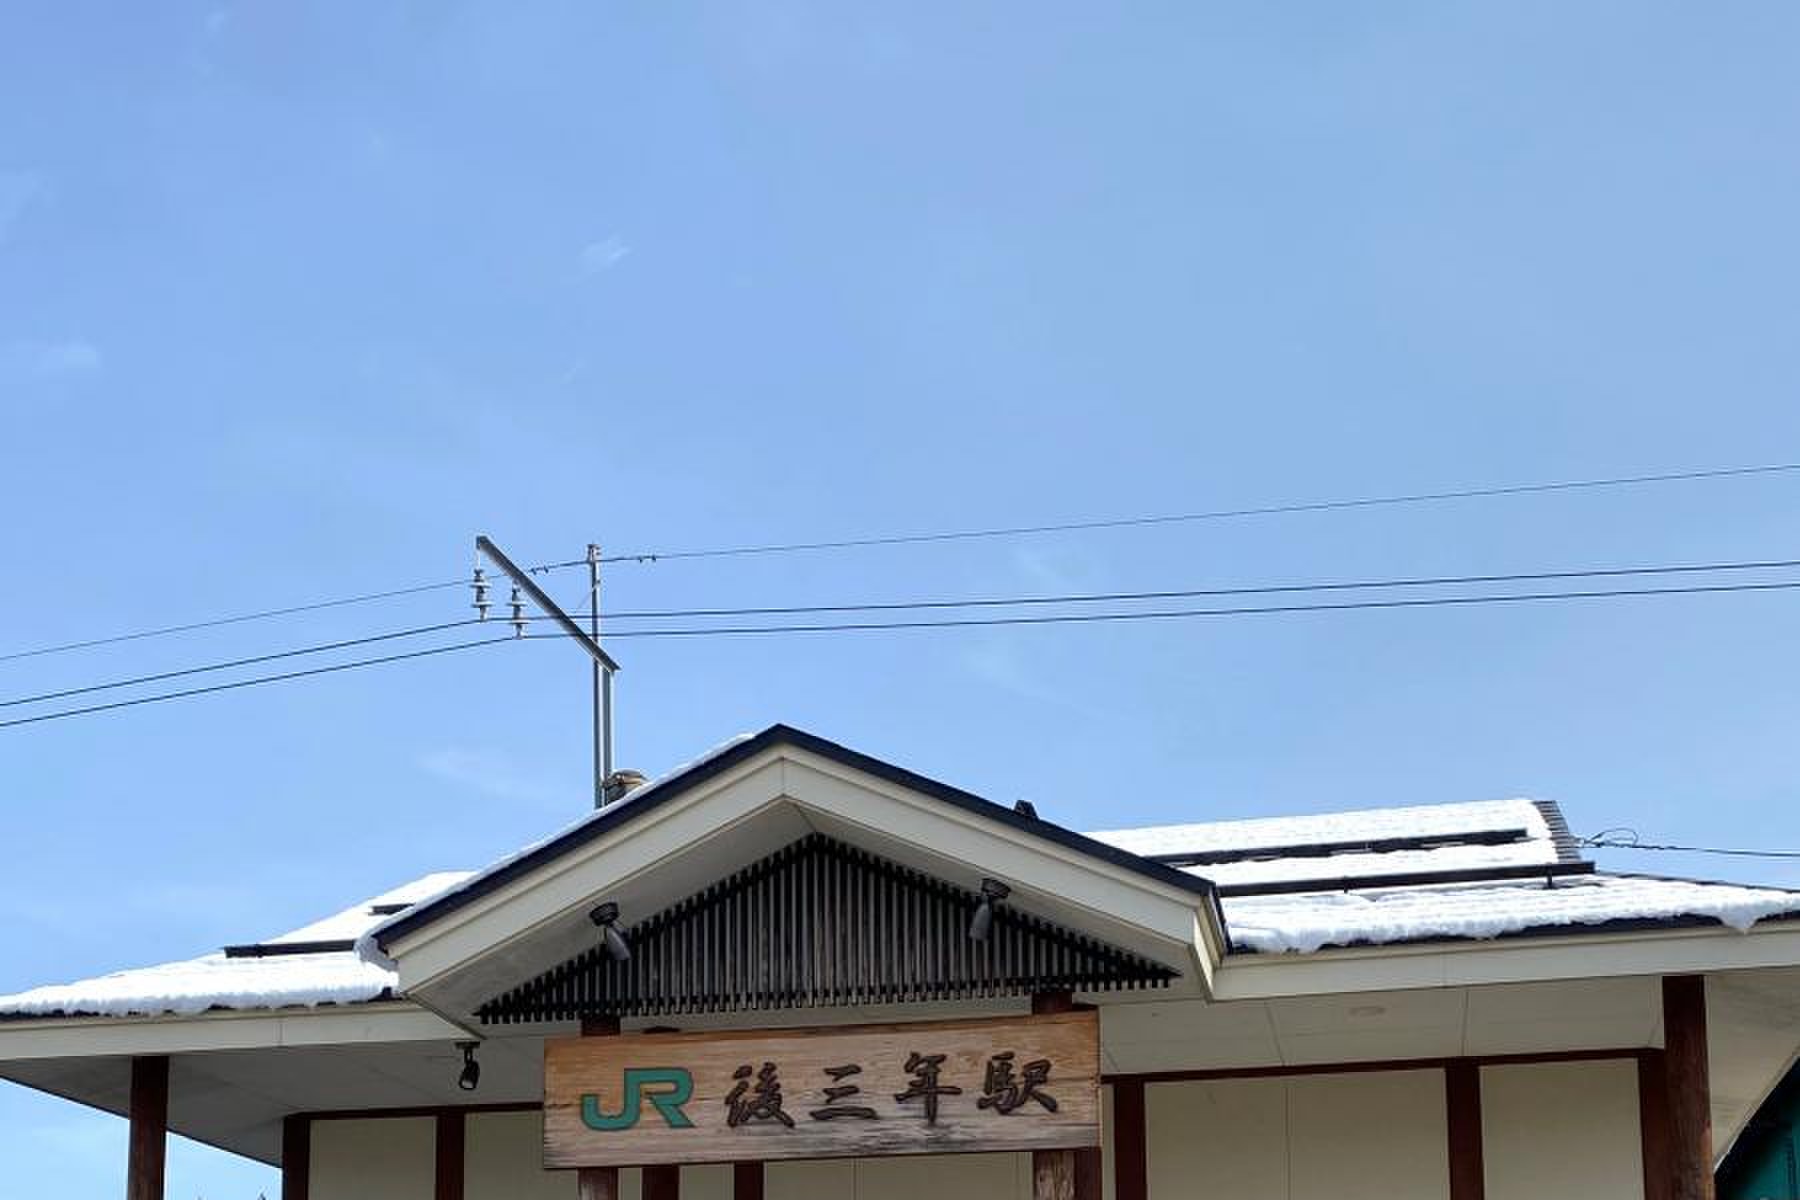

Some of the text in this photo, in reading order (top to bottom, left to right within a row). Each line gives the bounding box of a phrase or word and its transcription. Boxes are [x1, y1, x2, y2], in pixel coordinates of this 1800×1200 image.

[581, 1051, 1058, 1131] JR 後三年駅
